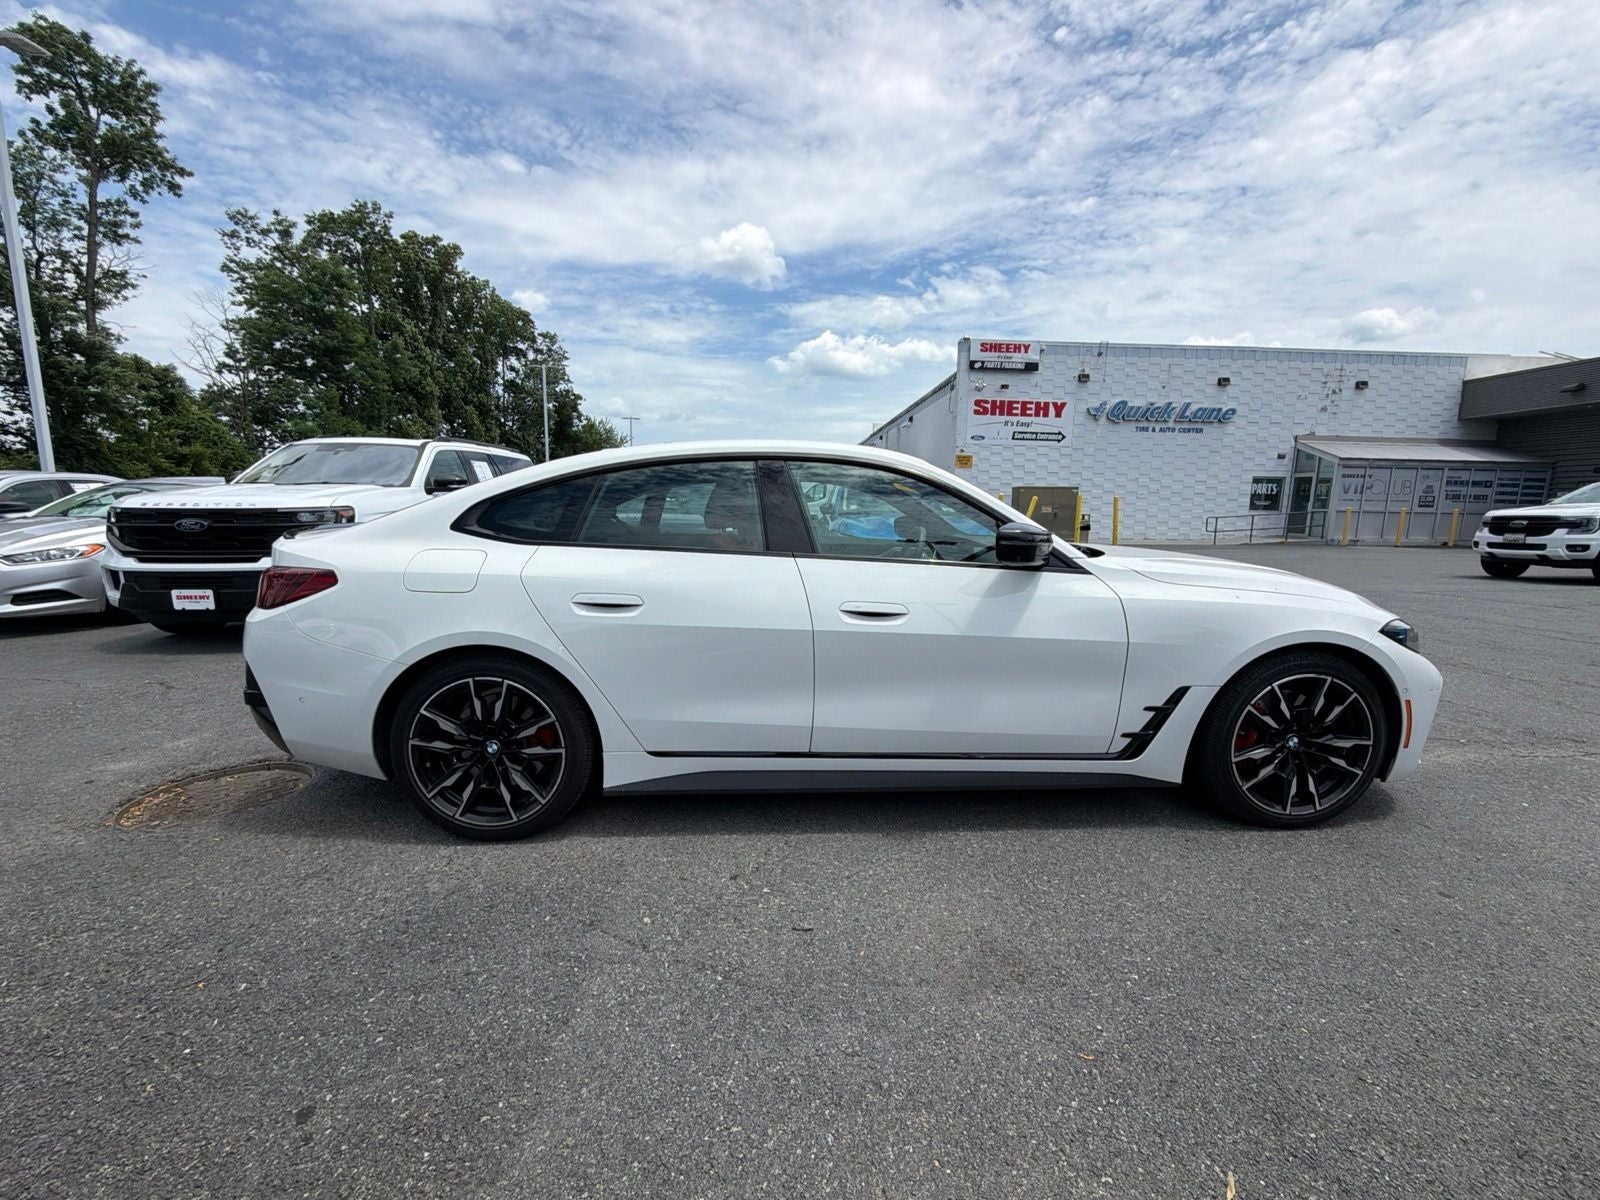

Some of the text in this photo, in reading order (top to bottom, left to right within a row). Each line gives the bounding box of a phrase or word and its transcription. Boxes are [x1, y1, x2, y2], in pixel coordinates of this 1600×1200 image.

[979, 342, 1032, 354] SHEEHY
[983, 361, 1026, 370] PARTS PARKING
[973, 399, 1068, 418] SHEEHY
[1107, 400, 1237, 423] Quick Lane
[1016, 420, 1034, 429] Easy!
[1014, 432, 1063, 441] Service Entrance
[1251, 483, 1277, 495] PARTS
[180, 519, 203, 530] Ford
